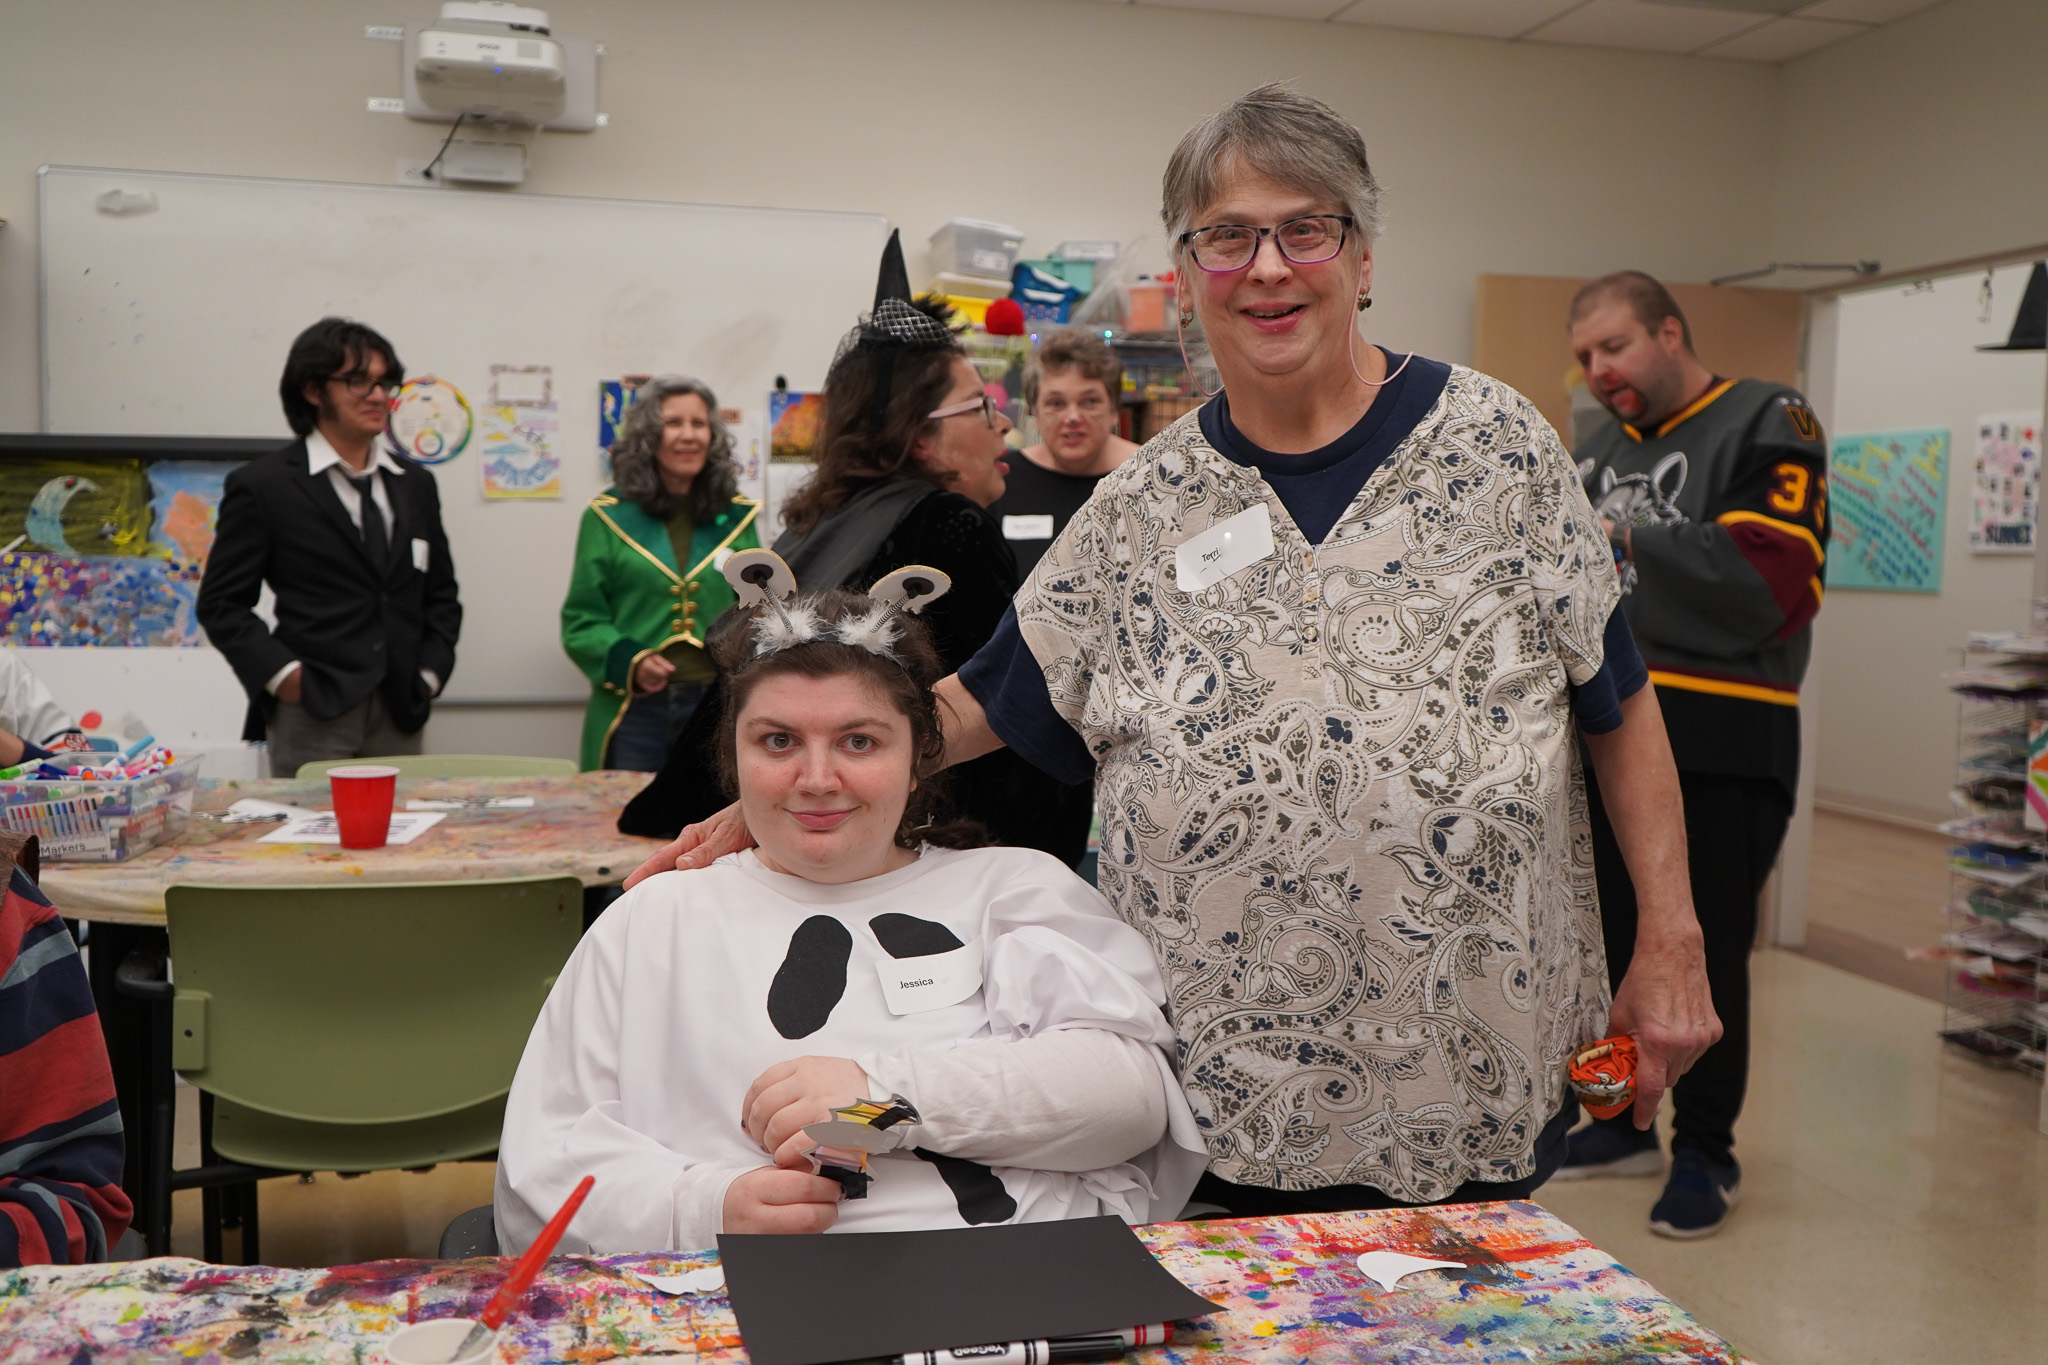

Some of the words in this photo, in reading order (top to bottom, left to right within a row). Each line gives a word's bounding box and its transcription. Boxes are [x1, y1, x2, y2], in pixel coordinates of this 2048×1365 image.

[1201, 547, 1219, 562] Terri
[40, 843, 86, 857] Markers
[900, 978, 934, 990] Jessica
